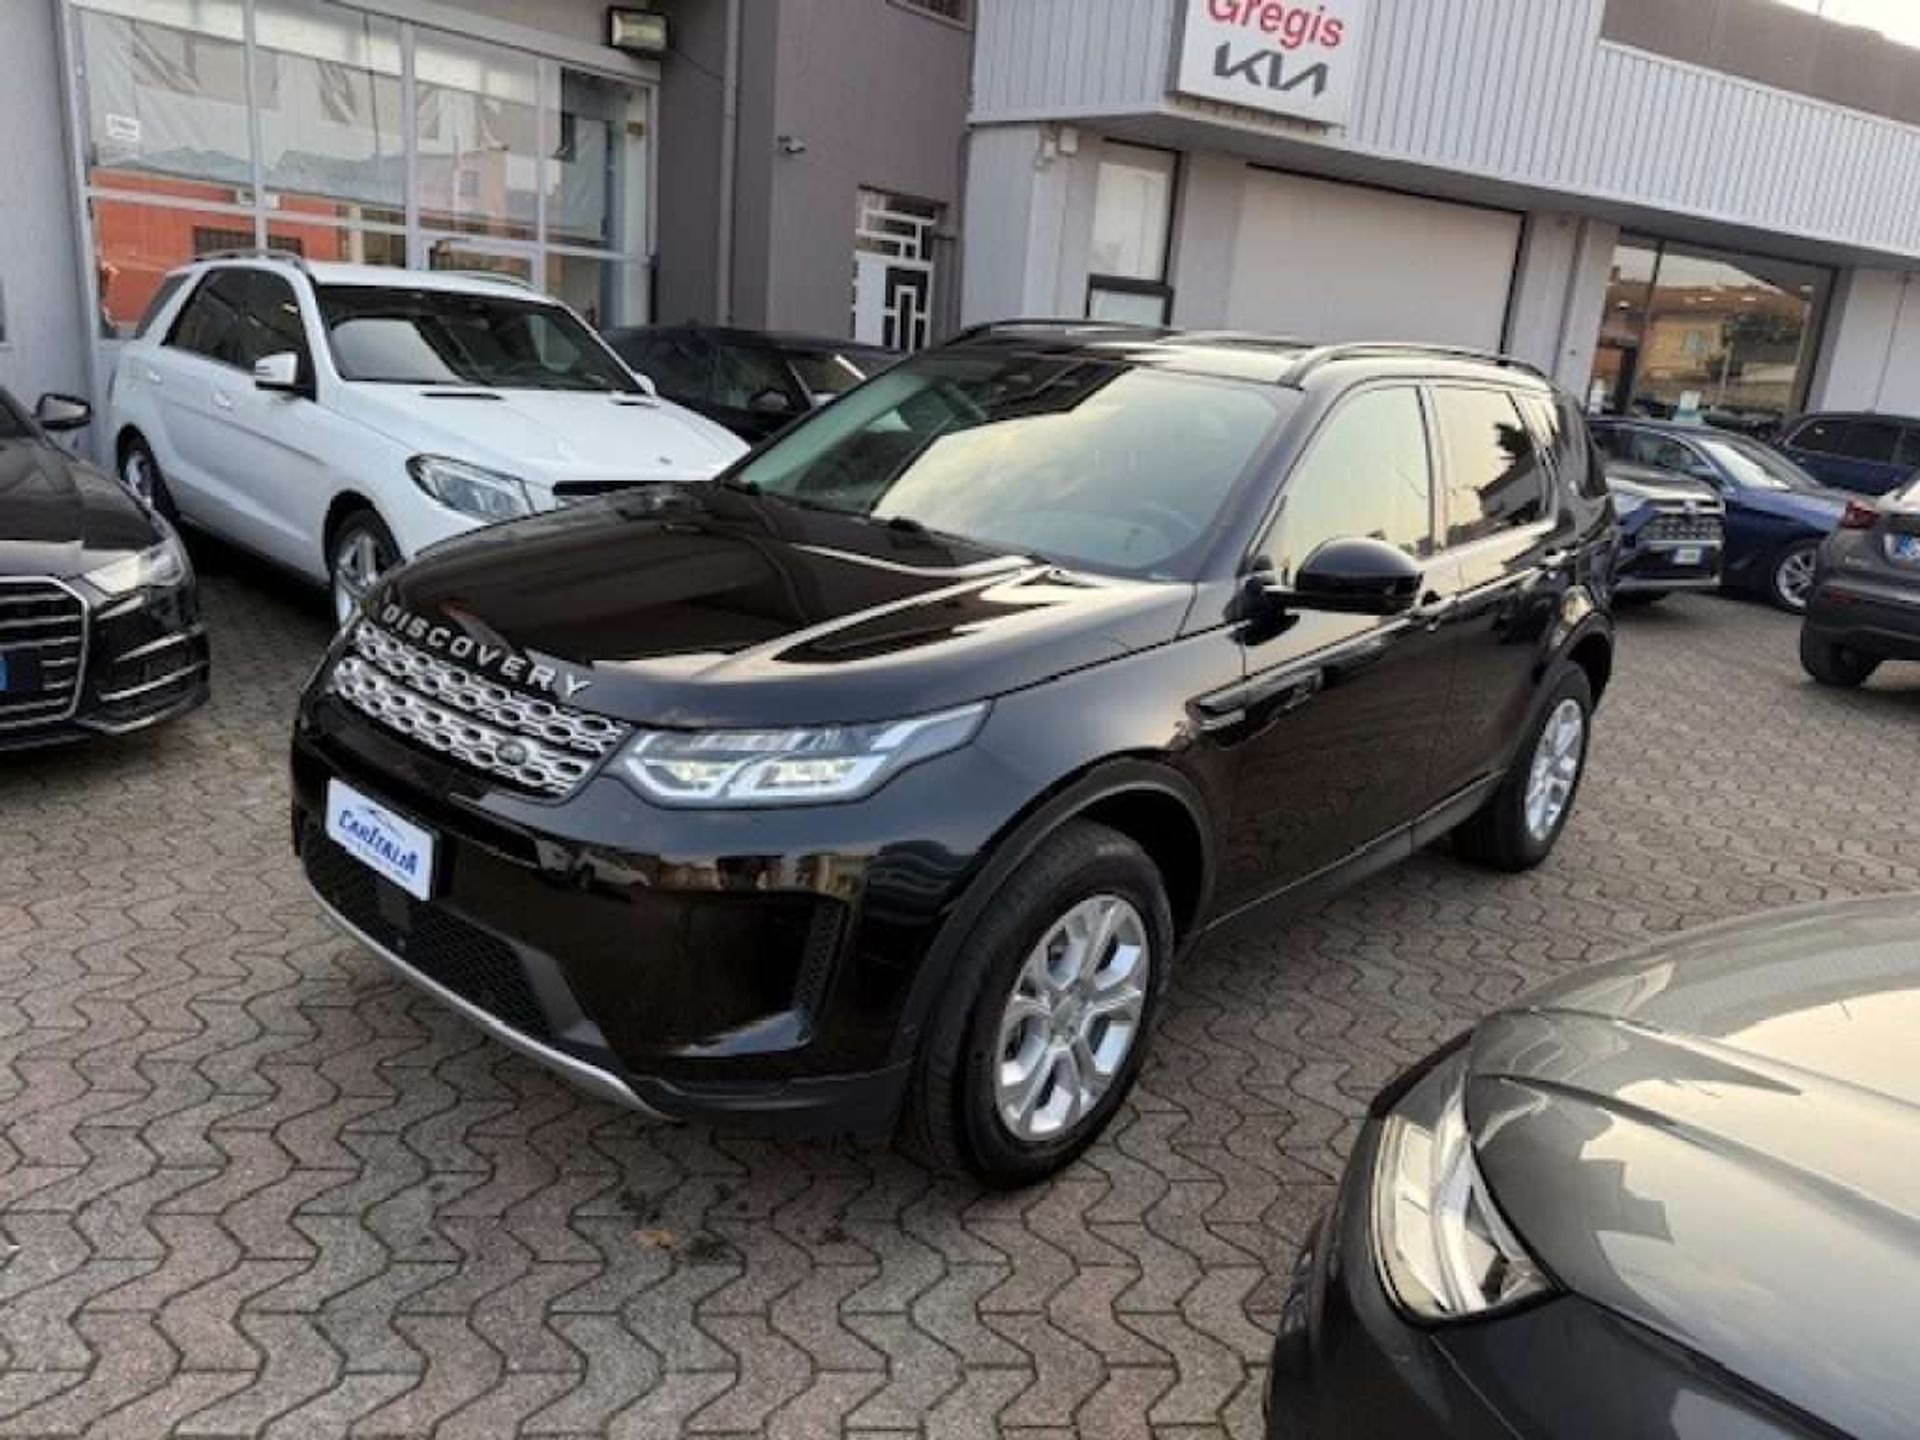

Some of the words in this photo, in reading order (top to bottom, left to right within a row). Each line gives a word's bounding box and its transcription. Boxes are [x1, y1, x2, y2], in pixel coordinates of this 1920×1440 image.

[1208, 0, 1344, 49] Gregis
[1214, 41, 1329, 97] KIA
[381, 603, 593, 698] DISCOVERY
